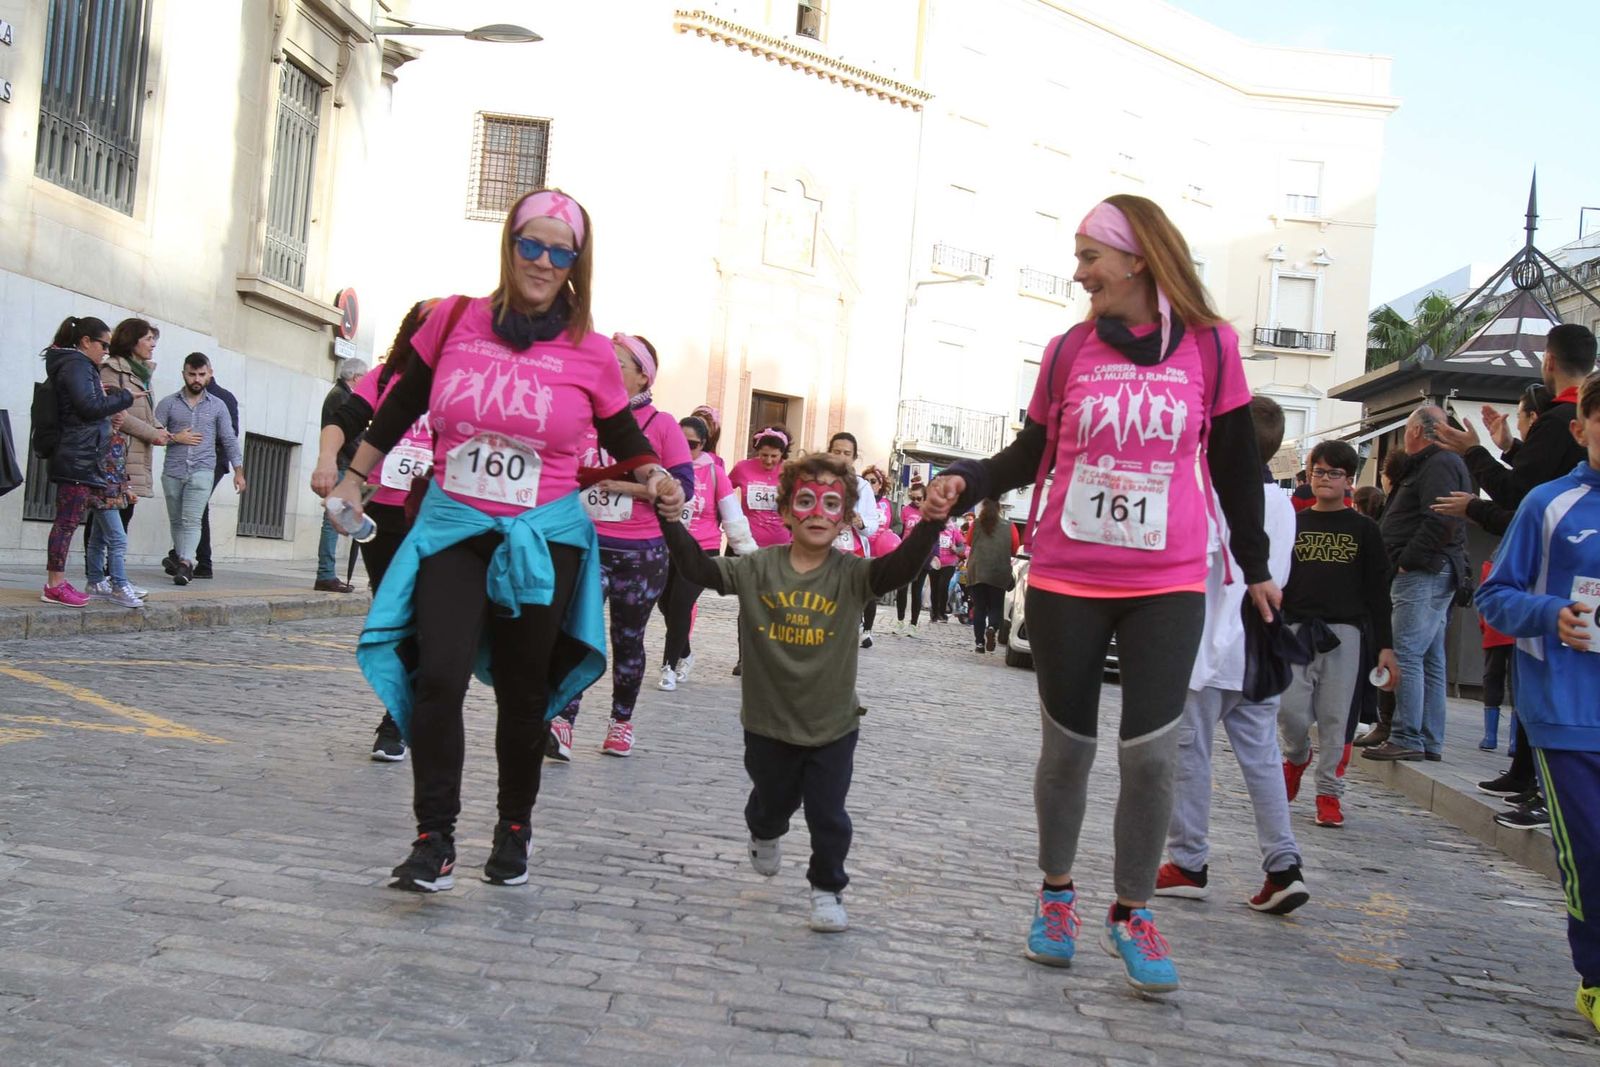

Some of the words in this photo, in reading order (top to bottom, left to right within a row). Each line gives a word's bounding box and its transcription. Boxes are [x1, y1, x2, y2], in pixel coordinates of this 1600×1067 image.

[1077, 375, 1090, 383] DE
[1091, 373, 1102, 382] LA
[1103, 371, 1137, 381] MUJER
[1146, 372, 1189, 385] RUNNING
[1094, 364, 1136, 374] CARRERA
[1165, 366, 1186, 377] PINK
[467, 447, 526, 481] 160
[587, 489, 623, 507] 637
[755, 492, 776, 502] 541
[1090, 491, 1147, 525] 161
[1296, 531, 1359, 548] STAR
[1294, 545, 1358, 563] WARS
[785, 612, 810, 626] PARA
[768, 622, 825, 646] LUCHAR
